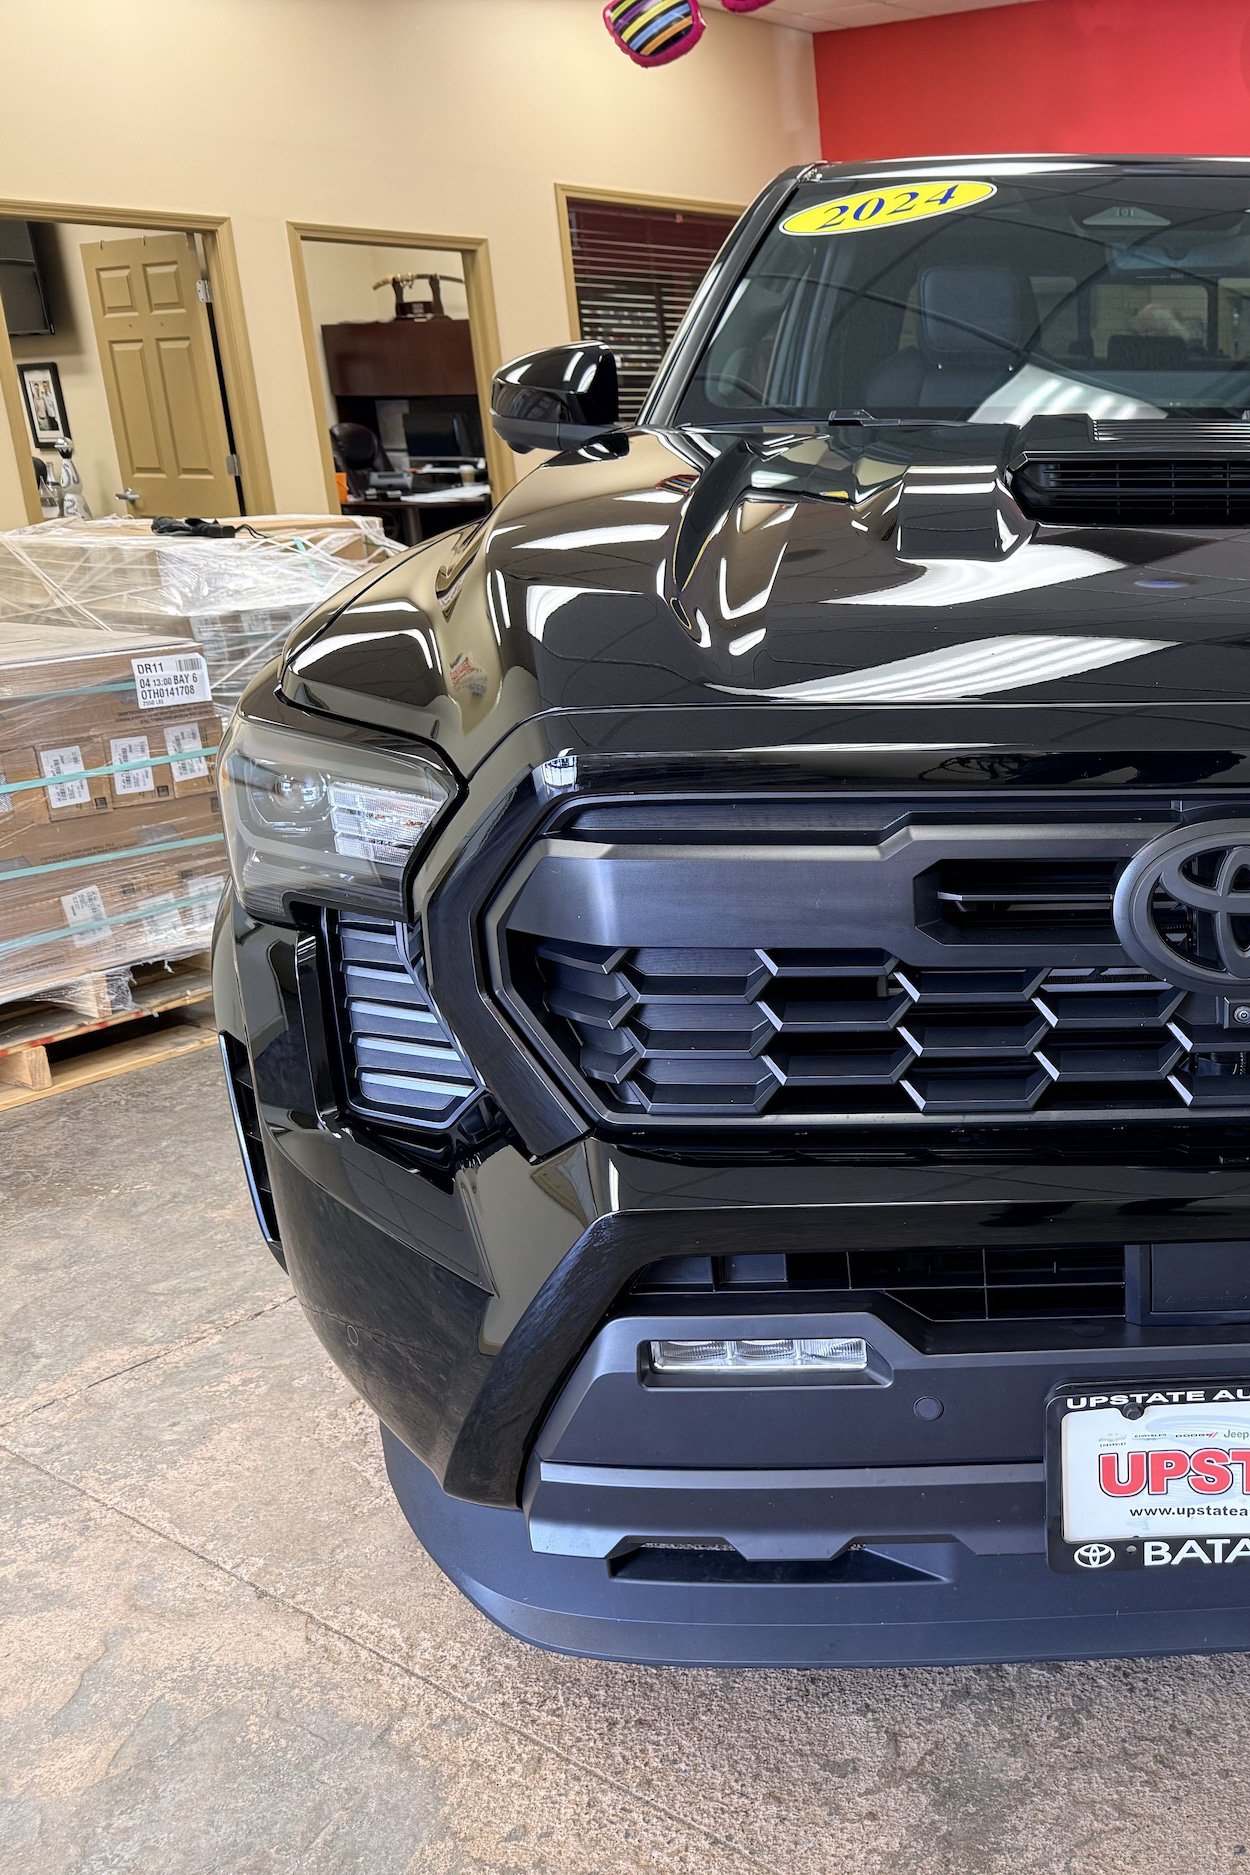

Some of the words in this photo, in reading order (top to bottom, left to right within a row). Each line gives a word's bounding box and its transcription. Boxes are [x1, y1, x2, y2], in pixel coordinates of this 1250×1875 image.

[815, 184, 960, 231] 2024
[137, 662, 164, 674] DR11
[140, 678, 151, 688] 04
[173, 673, 190, 685] BAY
[192, 673, 198, 683] 6
[1066, 1389, 1205, 1410] UPSTATE
[1223, 1429, 1249, 1440] Jeep
